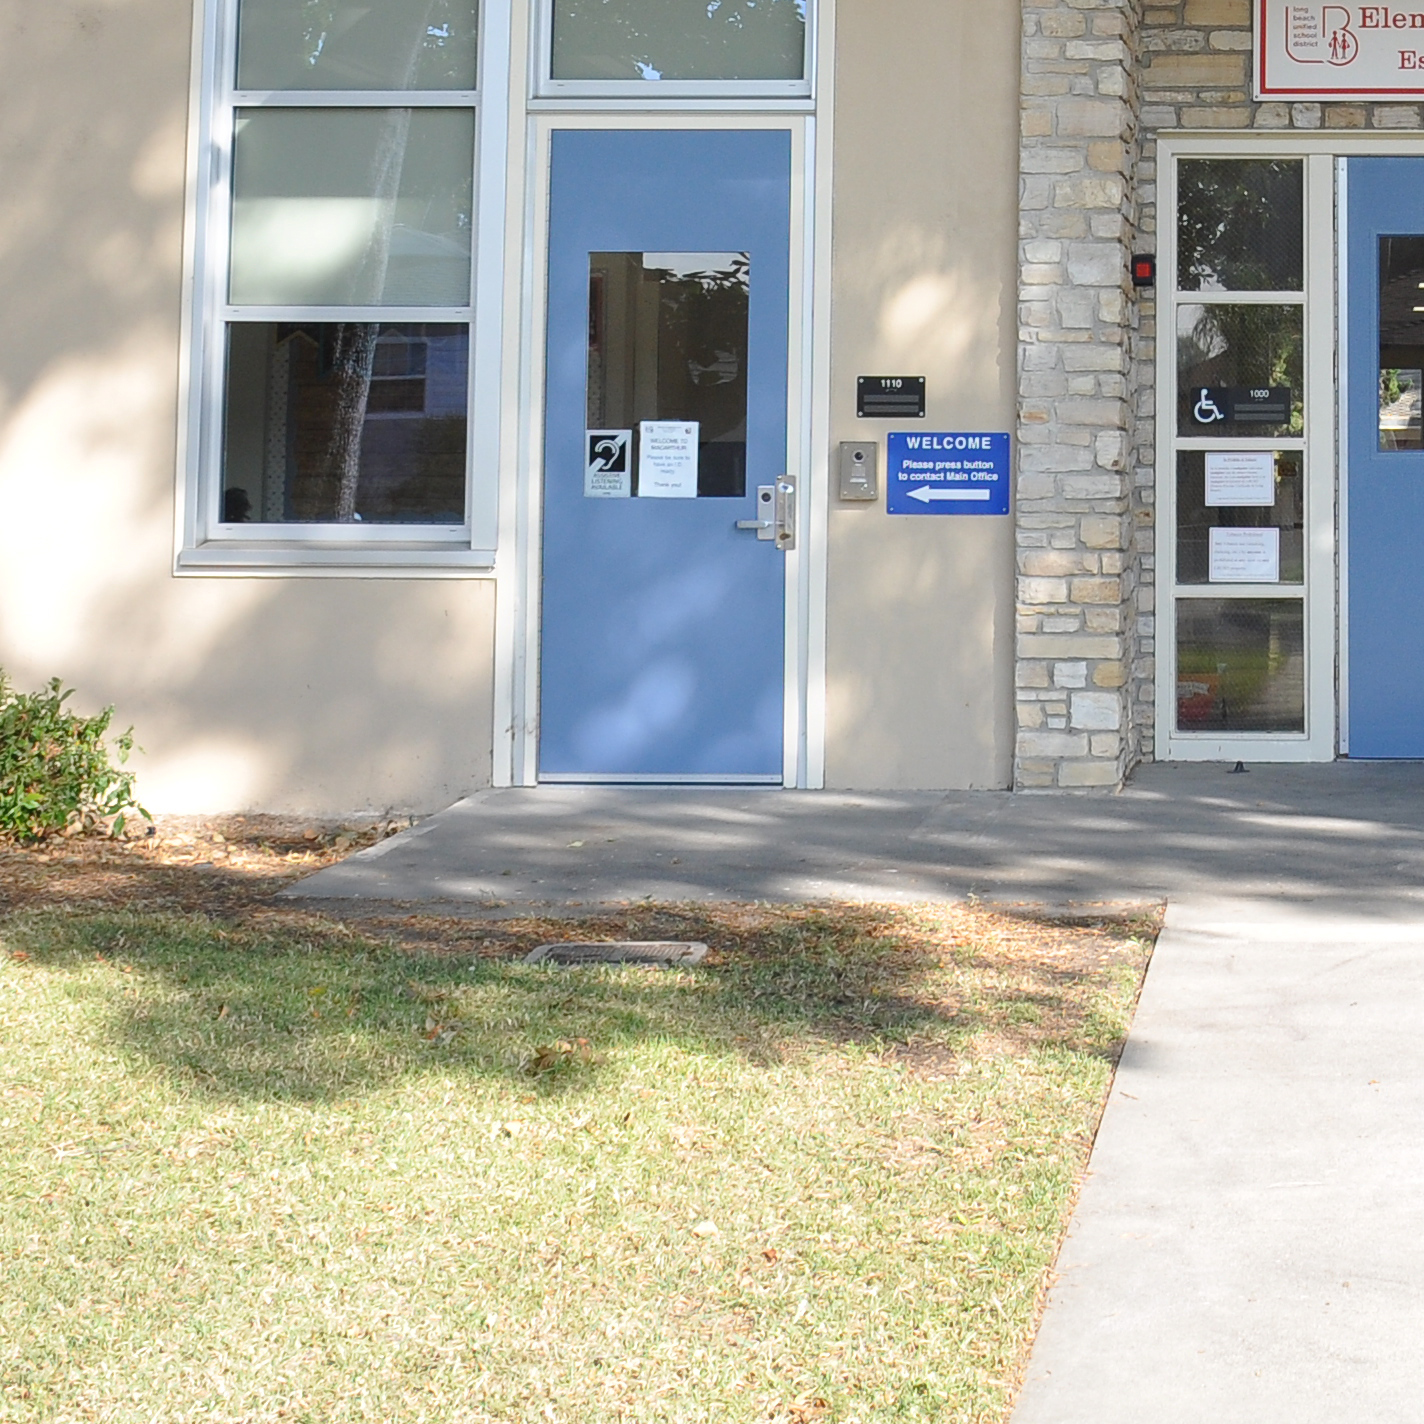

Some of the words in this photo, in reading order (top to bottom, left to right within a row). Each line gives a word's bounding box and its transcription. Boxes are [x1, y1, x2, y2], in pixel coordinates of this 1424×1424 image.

[1293, 14, 1316, 22] beach
[1293, 40, 1319, 48] district
[880, 379, 903, 388] 1110
[1249, 389, 1270, 398] 1000
[906, 437, 992, 450] WELCOME
[902, 460, 934, 469] Please
[935, 461, 961, 471] press
[963, 460, 994, 469] button
[898, 472, 907, 481] to
[909, 472, 944, 481] contact
[946, 472, 968, 480] Main
[970, 472, 999, 481] Office
